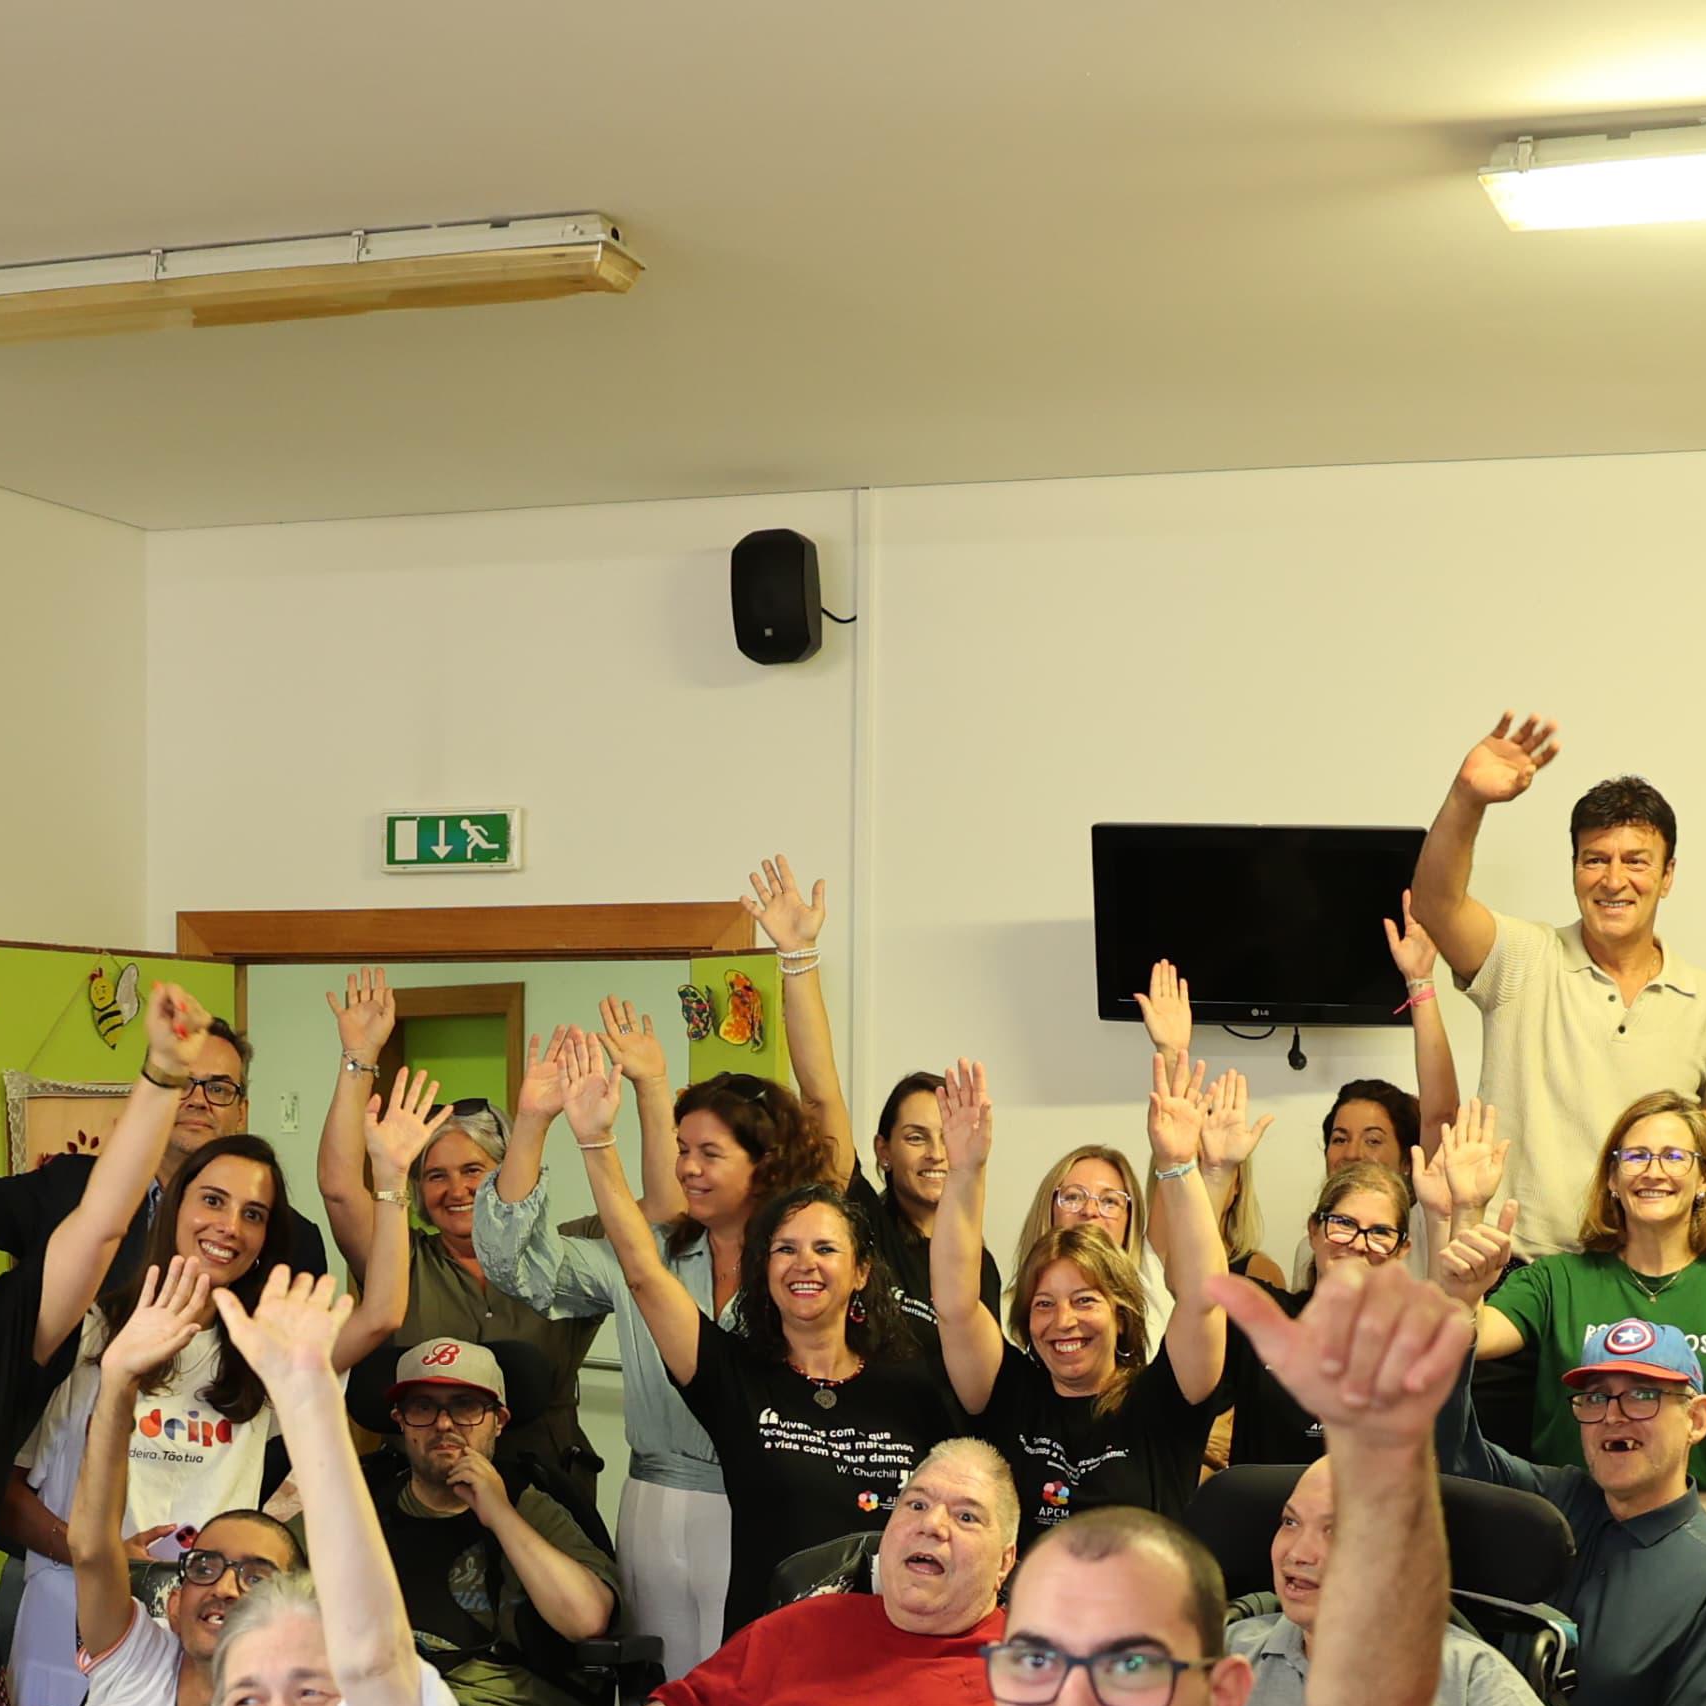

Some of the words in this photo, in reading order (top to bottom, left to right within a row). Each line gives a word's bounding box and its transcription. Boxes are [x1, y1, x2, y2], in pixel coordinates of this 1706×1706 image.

[420, 1343, 461, 1366] B
[830, 1428, 855, 1437] com
[869, 1432, 891, 1441] que
[765, 1441, 772, 1449] a
[775, 1440, 800, 1450] vida
[803, 1445, 829, 1456] com
[129, 1448, 161, 1461] deira.
[185, 1453, 204, 1463] tua
[853, 1467, 897, 1479] Churchill
[1039, 1506, 1069, 1518] APCM
